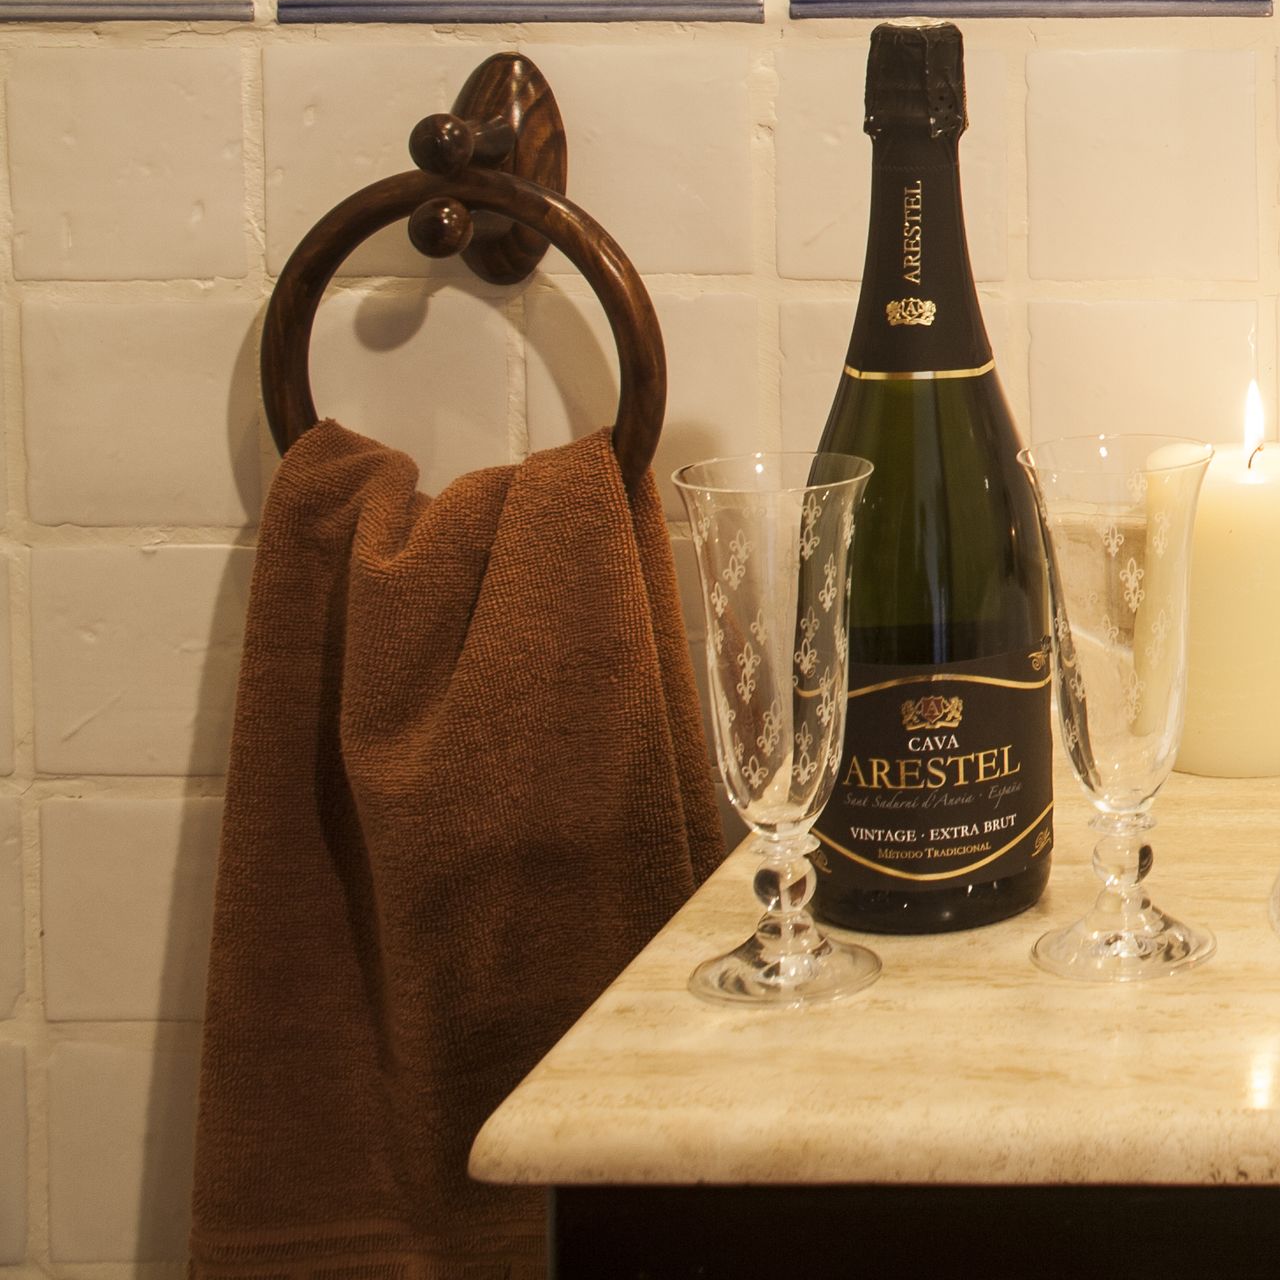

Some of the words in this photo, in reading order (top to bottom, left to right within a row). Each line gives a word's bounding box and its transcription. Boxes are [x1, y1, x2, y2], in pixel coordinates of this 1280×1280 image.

[903, 179, 923, 286] ARESTEL
[926, 700, 940, 717] A
[907, 733, 960, 752] CAVA
[842, 744, 1022, 790] ARESTEL
[850, 826, 918, 843] VINTAGE
[929, 823, 980, 842] EXTRA
[983, 813, 1018, 834] BRUT
